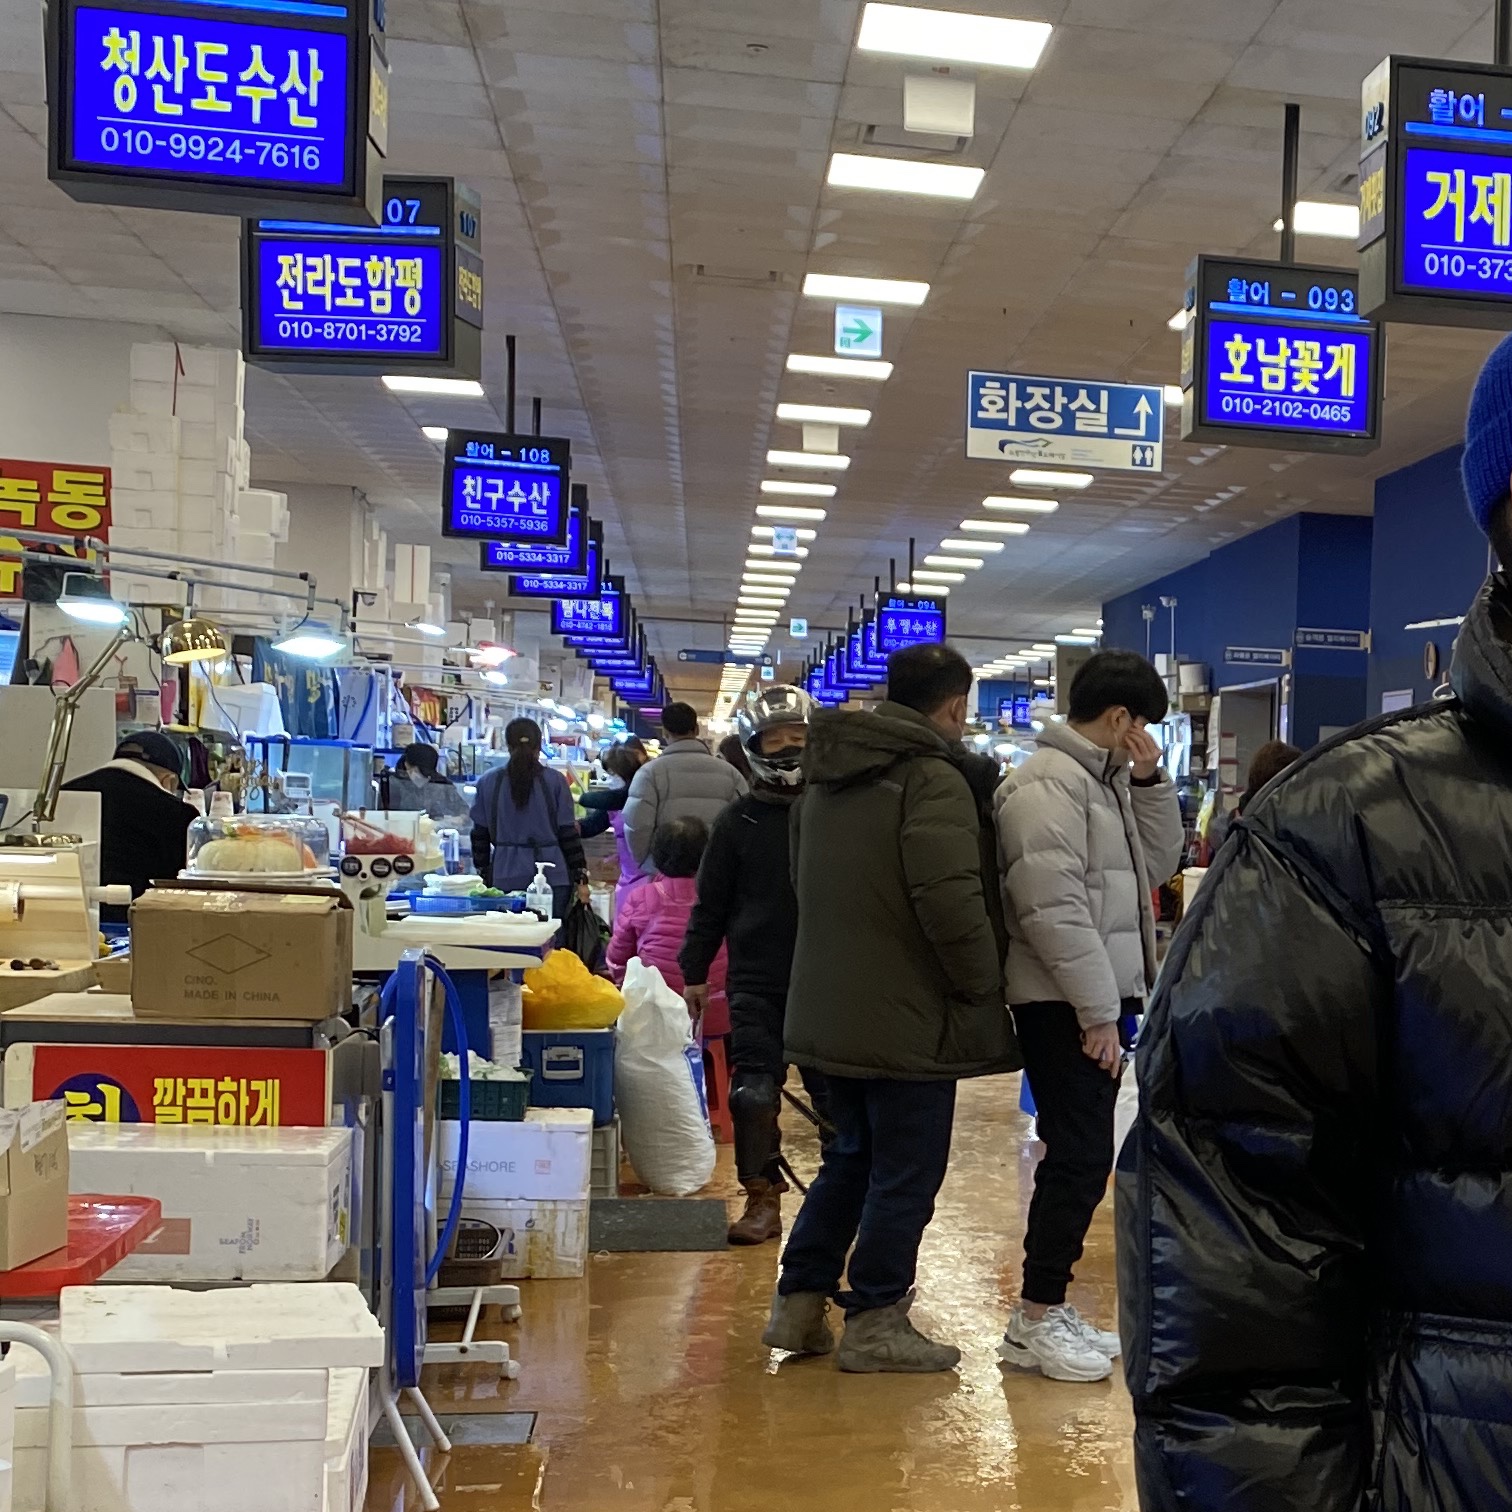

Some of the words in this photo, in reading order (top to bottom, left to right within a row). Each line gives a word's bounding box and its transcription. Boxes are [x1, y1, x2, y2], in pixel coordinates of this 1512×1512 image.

[101, 27, 324, 128] 청산도수산
[1429, 88, 1486, 127] 활어
[100, 126, 320, 171] 010-9924-7616
[276, 253, 423, 315] 전라도함평
[1228, 278, 1269, 306] 활어
[1308, 286, 1354, 312] 093
[278, 318, 422, 343] 010-8701-3792
[1220, 333, 1356, 397] 호남꽃게
[977, 380, 1109, 433] 화장실
[1222, 396, 1351, 422] 010-2102-0465
[519, 447, 550, 463] 108
[462, 475, 550, 515] 친구수산
[461, 514, 548, 531] 010-5357-5936
[496, 551, 570, 564] 010-5334-3317
[184, 990, 219, 1001] MADE
[224, 990, 237, 1001] IN
[242, 991, 280, 1002] CHINA
[153, 1076, 280, 1126] 깔끔하게
